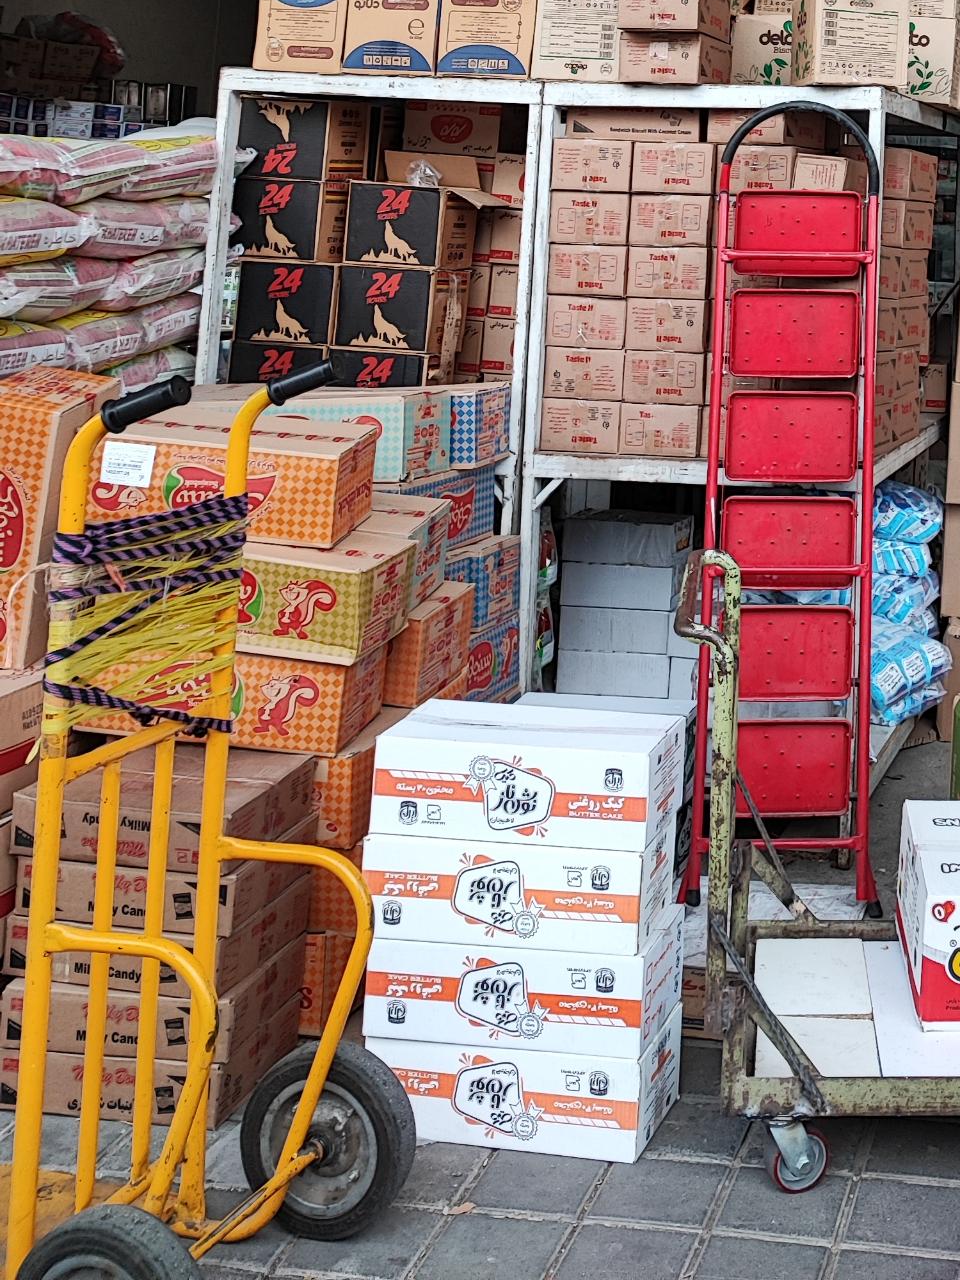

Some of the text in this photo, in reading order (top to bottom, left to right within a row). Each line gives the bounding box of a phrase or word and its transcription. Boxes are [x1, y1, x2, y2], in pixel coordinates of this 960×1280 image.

[261, 148, 297, 174] 24
[259, 183, 295, 209] 24
[376, 188, 412, 215] 24
[571, 199, 590, 208] Taste
[649, 253, 668, 261] Taste
[267, 267, 305, 293] 24
[366, 271, 403, 298] 24
[567, 303, 585, 311] Taste
[259, 348, 295, 375] 24
[565, 355, 583, 363] Taste
[356, 355, 395, 383] 24
[567, 795, 625, 811] کیک روغنی
[568, 811, 624, 820] BUTTER CAKE
[383, 872, 406, 880] CAKE
[382, 882, 406, 895] کیک
[406, 881, 439, 897] روغنی
[108, 967, 142, 983] Candy
[409, 975, 442, 983] BUTTER
[386, 983, 410, 997] کیک
[409, 982, 442, 999] روغنی
[407, 1079, 439, 1096] روغنی
